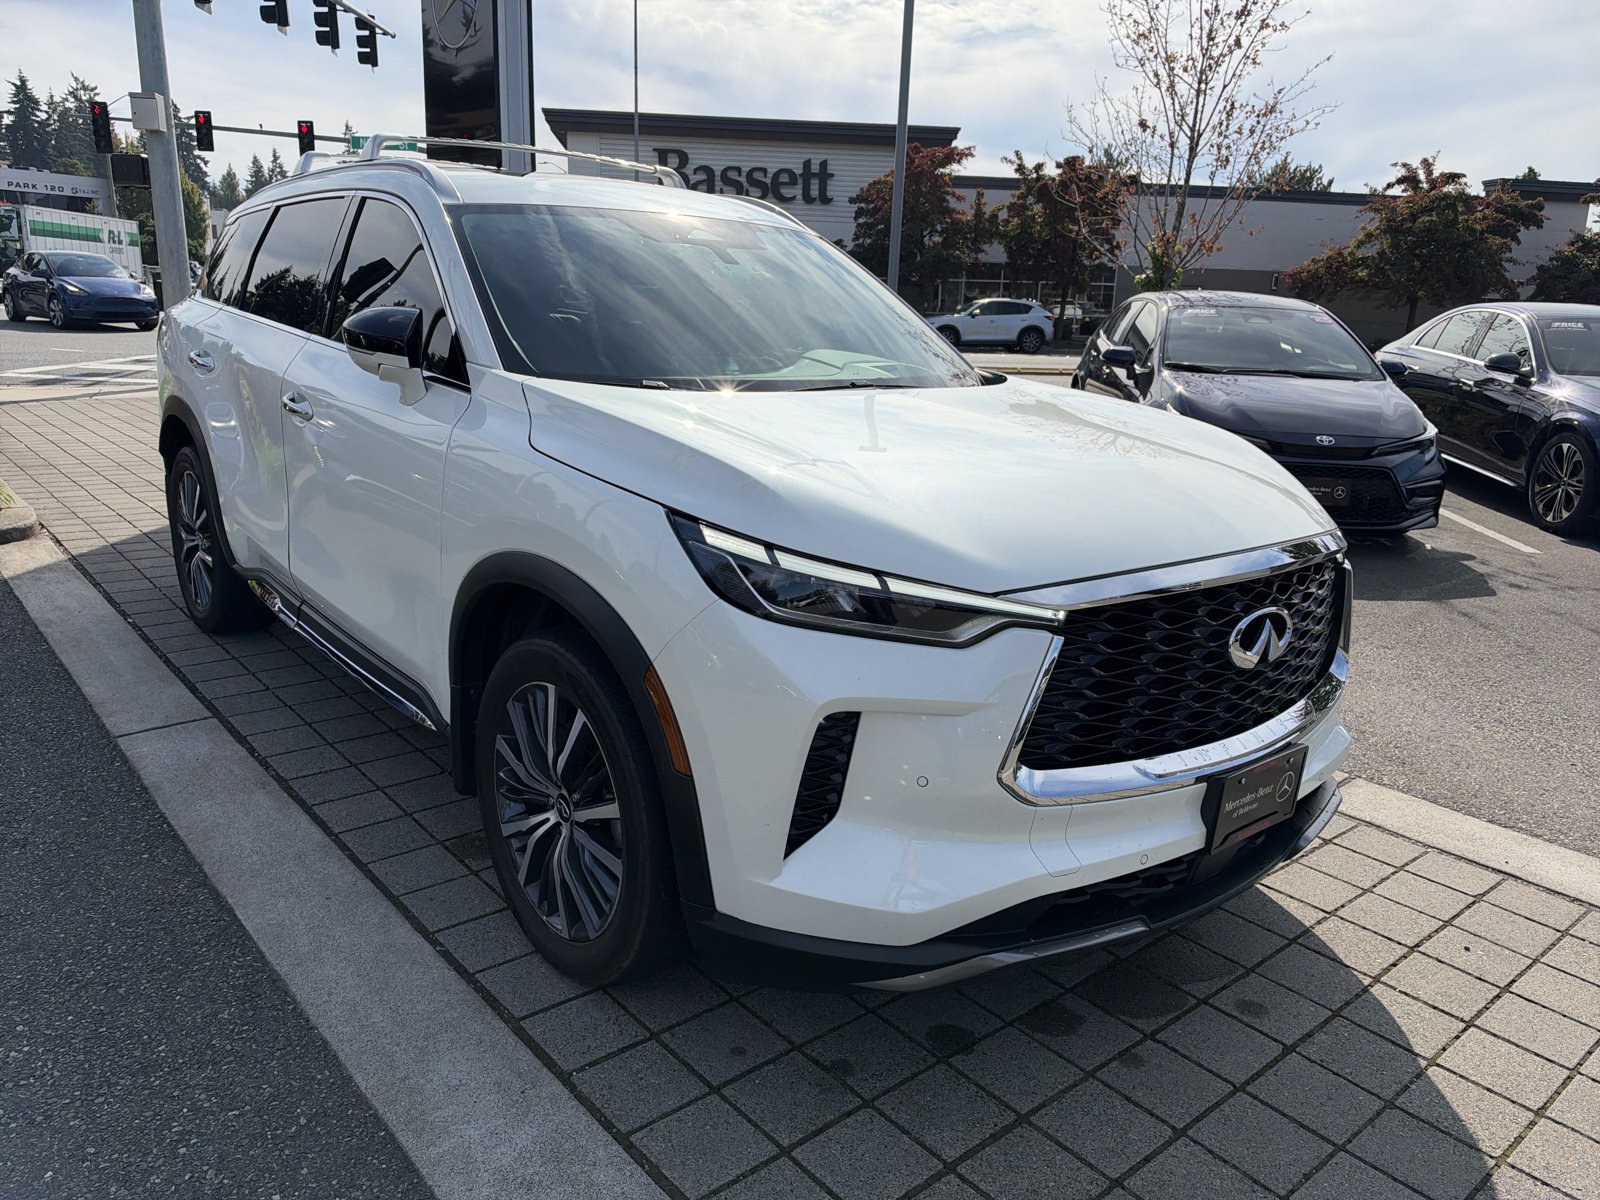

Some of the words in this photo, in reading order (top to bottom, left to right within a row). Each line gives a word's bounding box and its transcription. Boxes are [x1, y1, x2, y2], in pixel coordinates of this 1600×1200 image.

[7, 180, 39, 190] PARK
[44, 184, 65, 193] 120
[652, 147, 835, 205] Bassett
[1224, 784, 1274, 813] Mercedes-Benz
